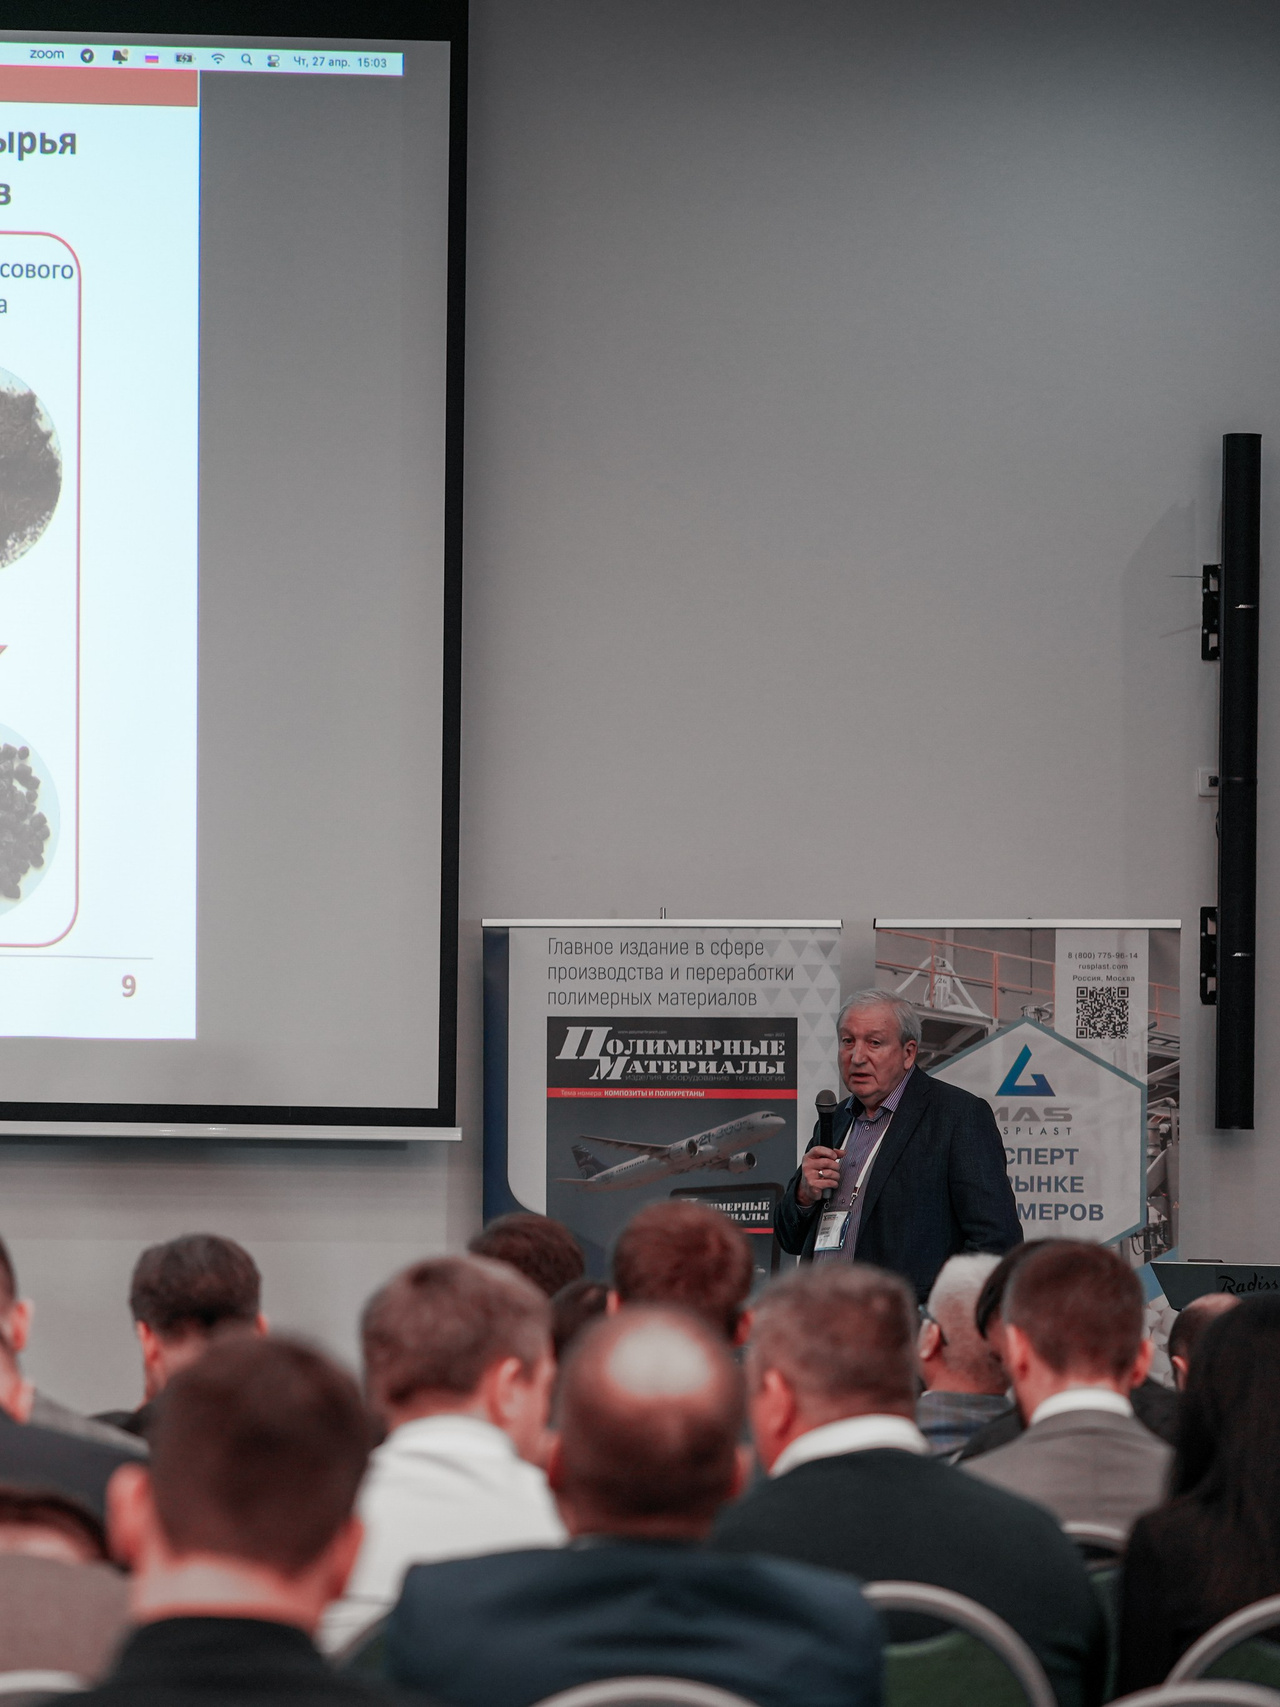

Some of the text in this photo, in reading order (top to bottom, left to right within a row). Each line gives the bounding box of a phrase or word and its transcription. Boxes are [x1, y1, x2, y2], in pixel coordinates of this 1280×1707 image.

[29, 48, 65, 60] zoom
[293, 55, 388, 69] Чт, 27 апр. 15:03
[547, 937, 765, 961] Главное издание в сфере
[1074, 950, 1096, 961] (800)
[547, 963, 795, 985] производства и переработки
[1078, 962, 1129, 971] rusplast.com
[121, 973, 137, 998] 9
[1105, 974, 1136, 983] Москва
[547, 991, 758, 1010] полимерных материалов
[555, 1026, 786, 1060] ПОЛИМЕРНЫЕ
[588, 1056, 786, 1080] МАТЕРИАЛЫ
[625, 1073, 786, 1083] изделия оборудование технологии
[603, 1089, 648, 1098] КОМПОЗИТЫ
[654, 1089, 705, 1098] ПОЛИУРЕТАНЫ
[1003, 1126, 1072, 1136] SPLAST
[1004, 1146, 1080, 1166] СПЕРТ
[1016, 1203, 1104, 1221] МЕРОВ
[1217, 1271, 1280, 1296] Radiss
